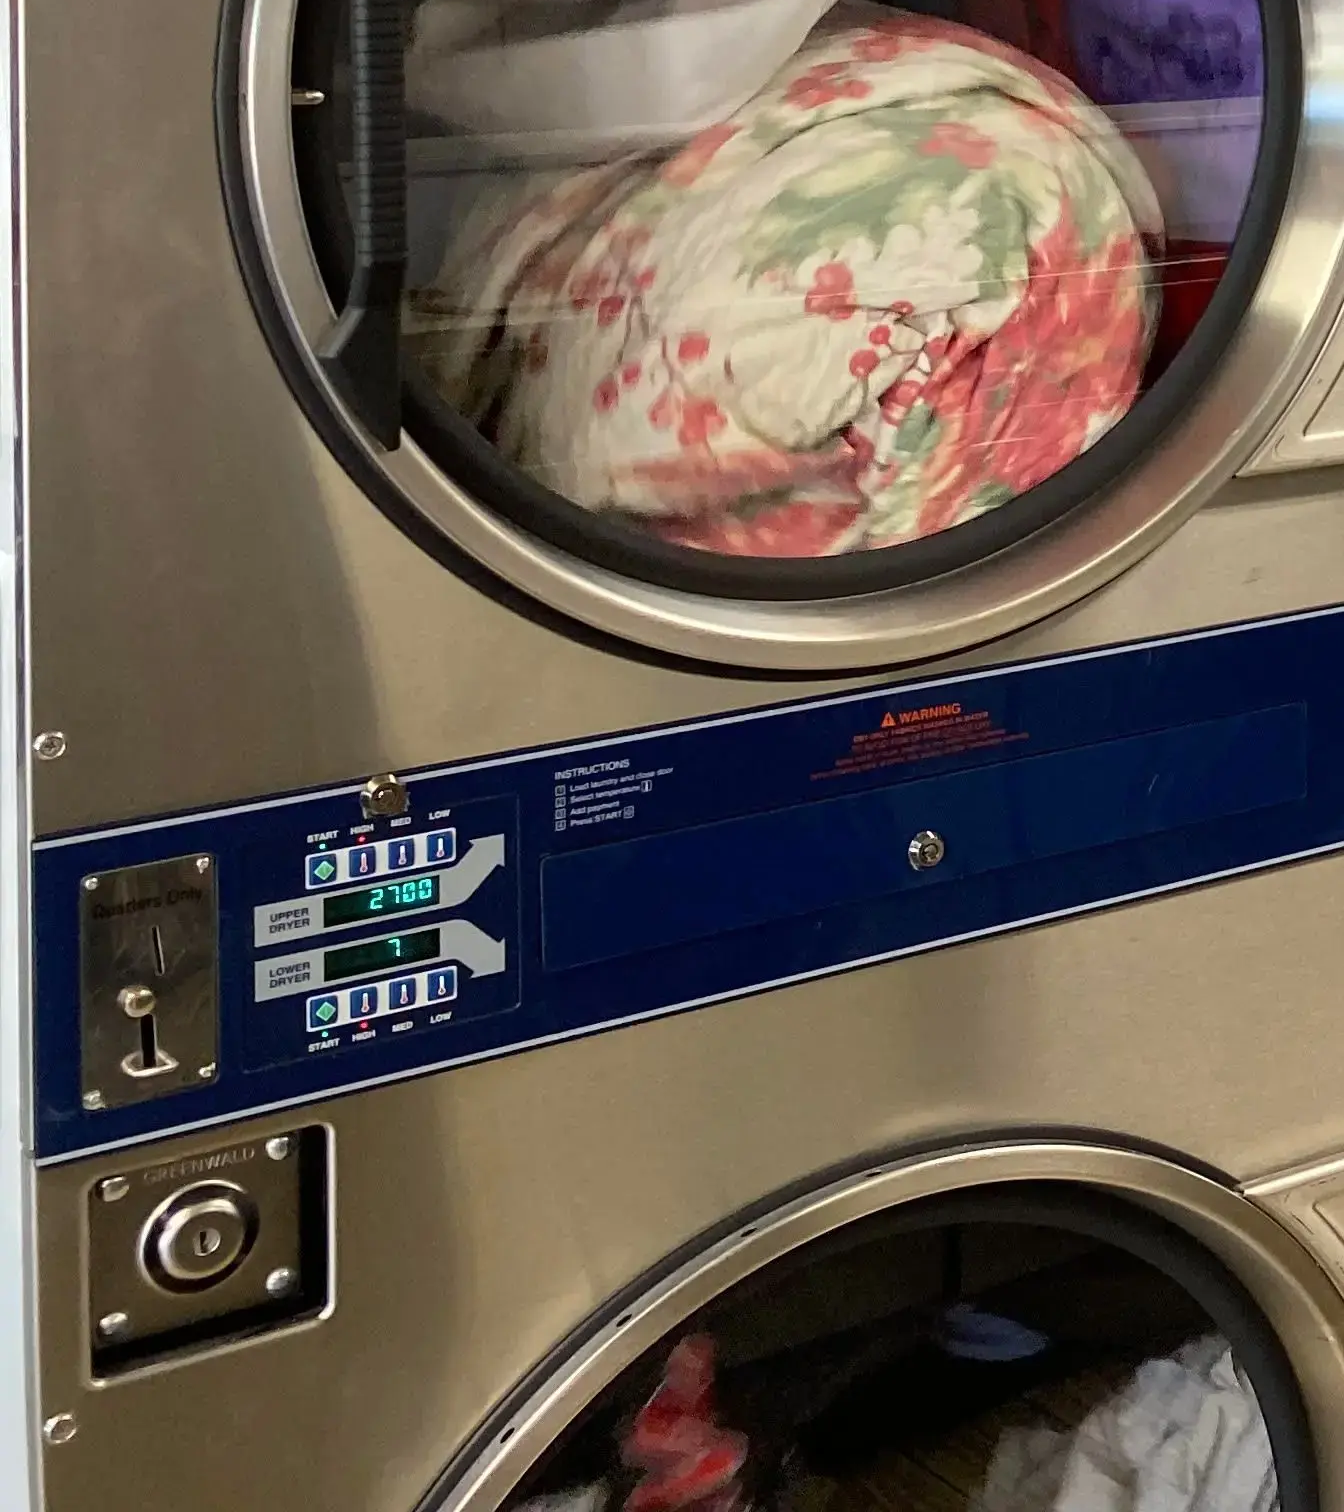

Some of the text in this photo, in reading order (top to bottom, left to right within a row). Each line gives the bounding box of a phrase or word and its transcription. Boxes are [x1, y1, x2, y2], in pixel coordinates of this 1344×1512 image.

[898, 703, 961, 724] WARNING
[555, 759, 630, 780] INSTRUCTIONS
[307, 809, 451, 844] START HIGH MED LOW
[595, 810, 622, 823] START
[369, 878, 433, 910] 2700
[269, 908, 310, 924] UPPER
[269, 918, 311, 934] DRYER
[388, 938, 401, 957] 7
[269, 962, 311, 978] LOWER
[269, 972, 311, 988] DRYER
[308, 1011, 452, 1052] START HIGH MED LOW
[143, 1147, 255, 1182] GREENWALD
